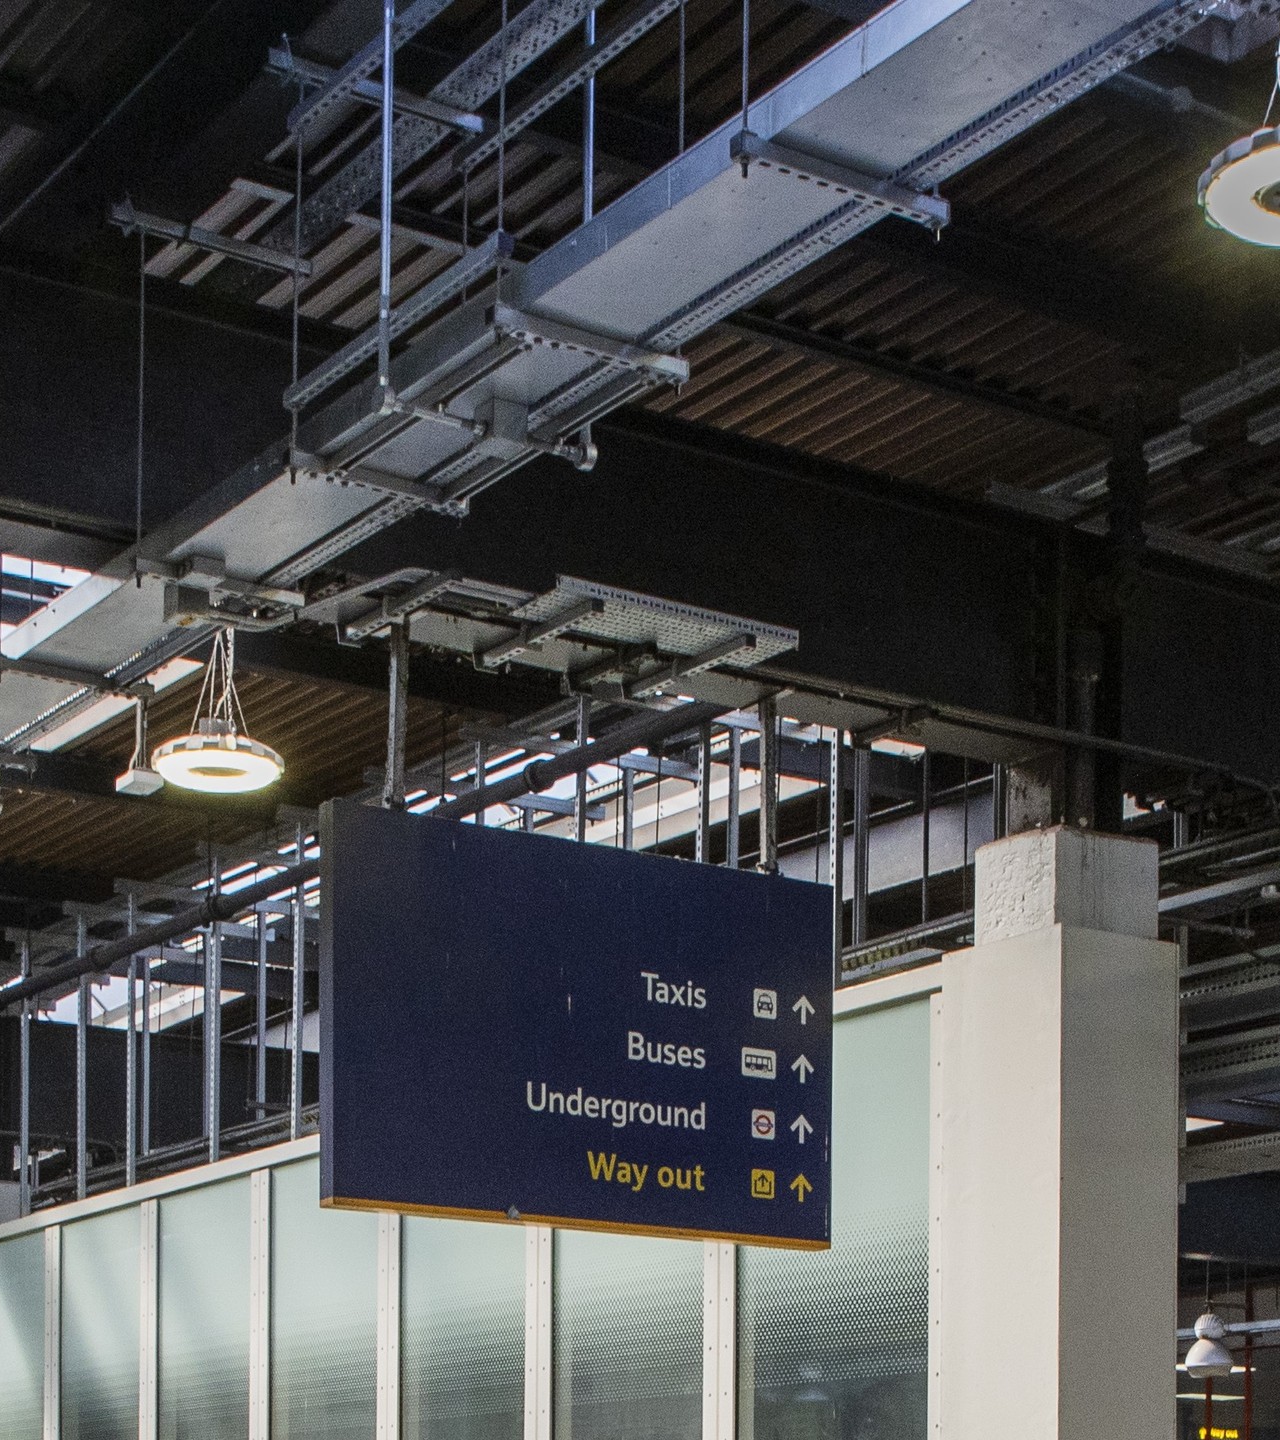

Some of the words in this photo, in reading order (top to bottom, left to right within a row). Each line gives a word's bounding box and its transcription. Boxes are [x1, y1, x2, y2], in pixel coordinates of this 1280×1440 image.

[640, 971, 707, 1010] Taxis
[627, 1031, 707, 1069] Buses
[525, 1081, 707, 1130] Underground
[586, 1151, 649, 1191] Way
[657, 1163, 706, 1191] out
